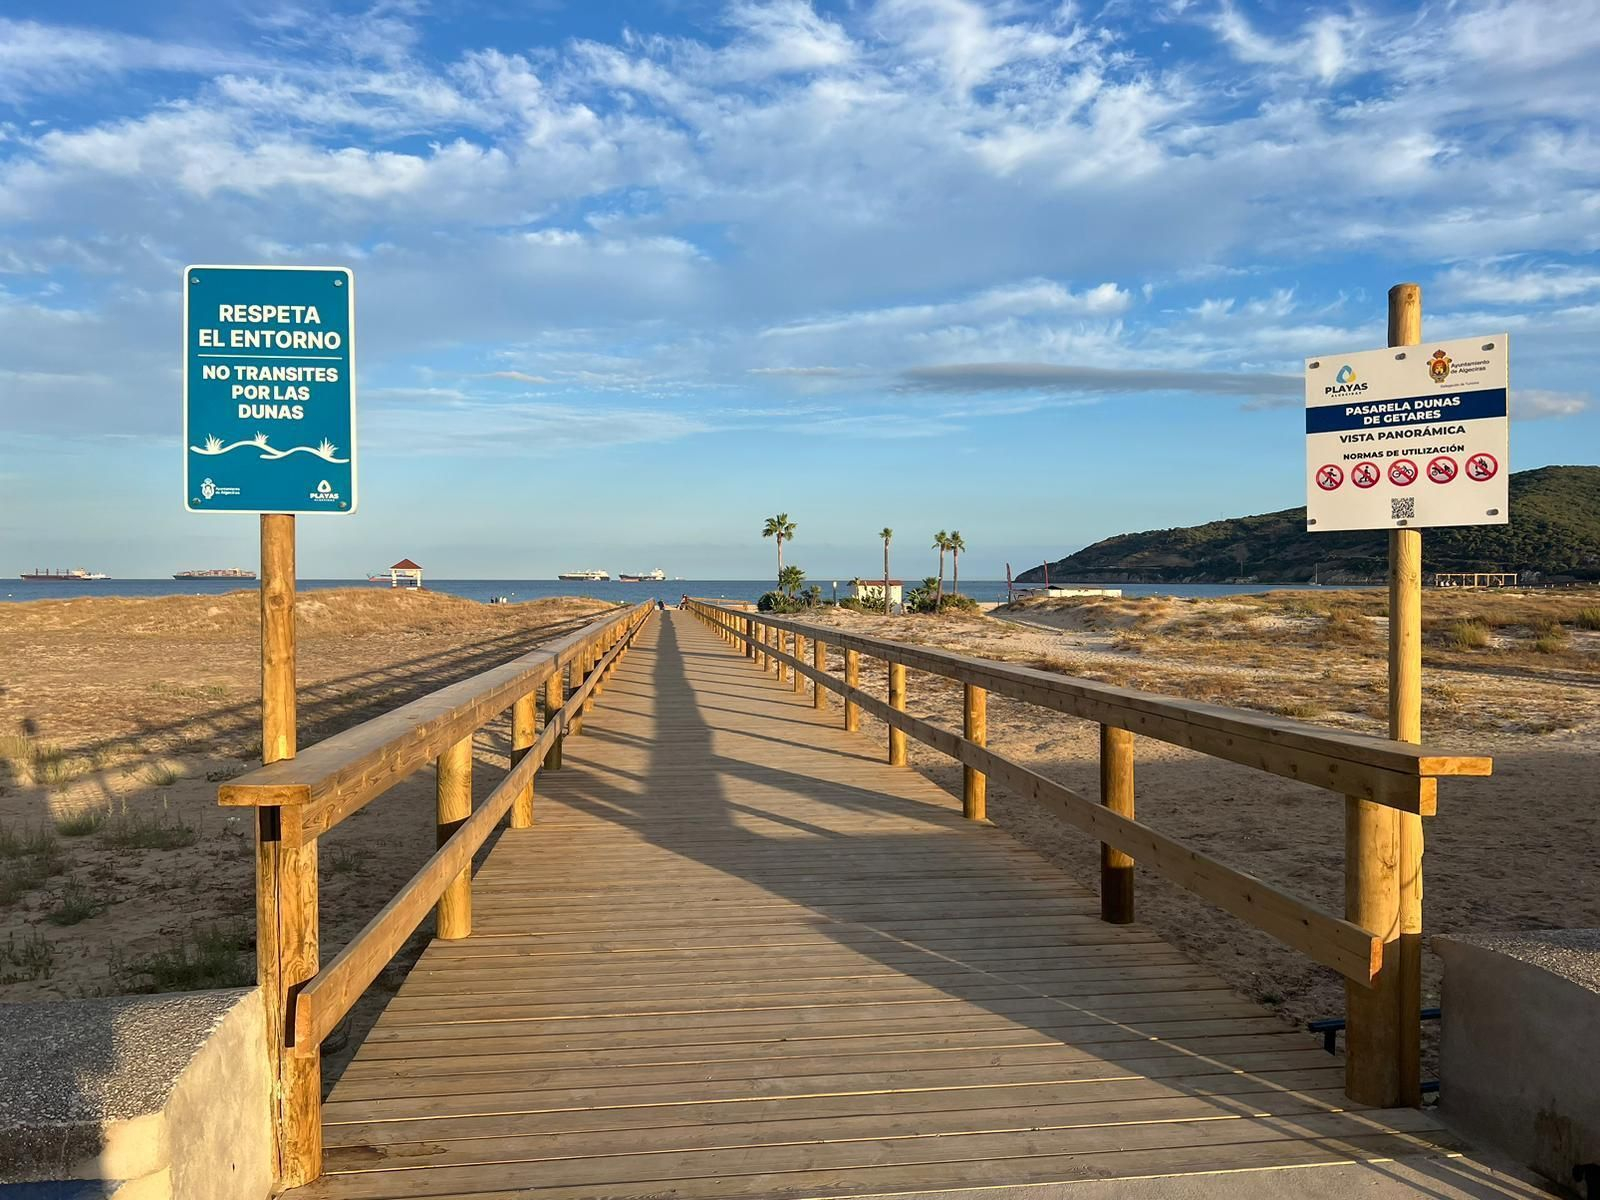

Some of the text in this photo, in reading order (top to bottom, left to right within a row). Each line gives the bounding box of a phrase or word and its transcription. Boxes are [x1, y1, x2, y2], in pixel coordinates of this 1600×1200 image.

[219, 304, 321, 324] RESPETA
[199, 329, 341, 350] EL ENTORNO
[202, 365, 338, 382] NO TRANSITES
[1458, 366, 1487, 374] Algeciras
[231, 385, 310, 401] POR LAS
[1325, 382, 1369, 395] PLAYAS
[238, 404, 304, 420] DUNAS
[1345, 396, 1461, 417] PASARELA DUNAS
[1363, 409, 1442, 425] DE GETARES
[1340, 425, 1466, 444] VISTA PANORÁMICA
[1343, 444, 1465, 461] NORMAS DE UTILIZACIÓN
